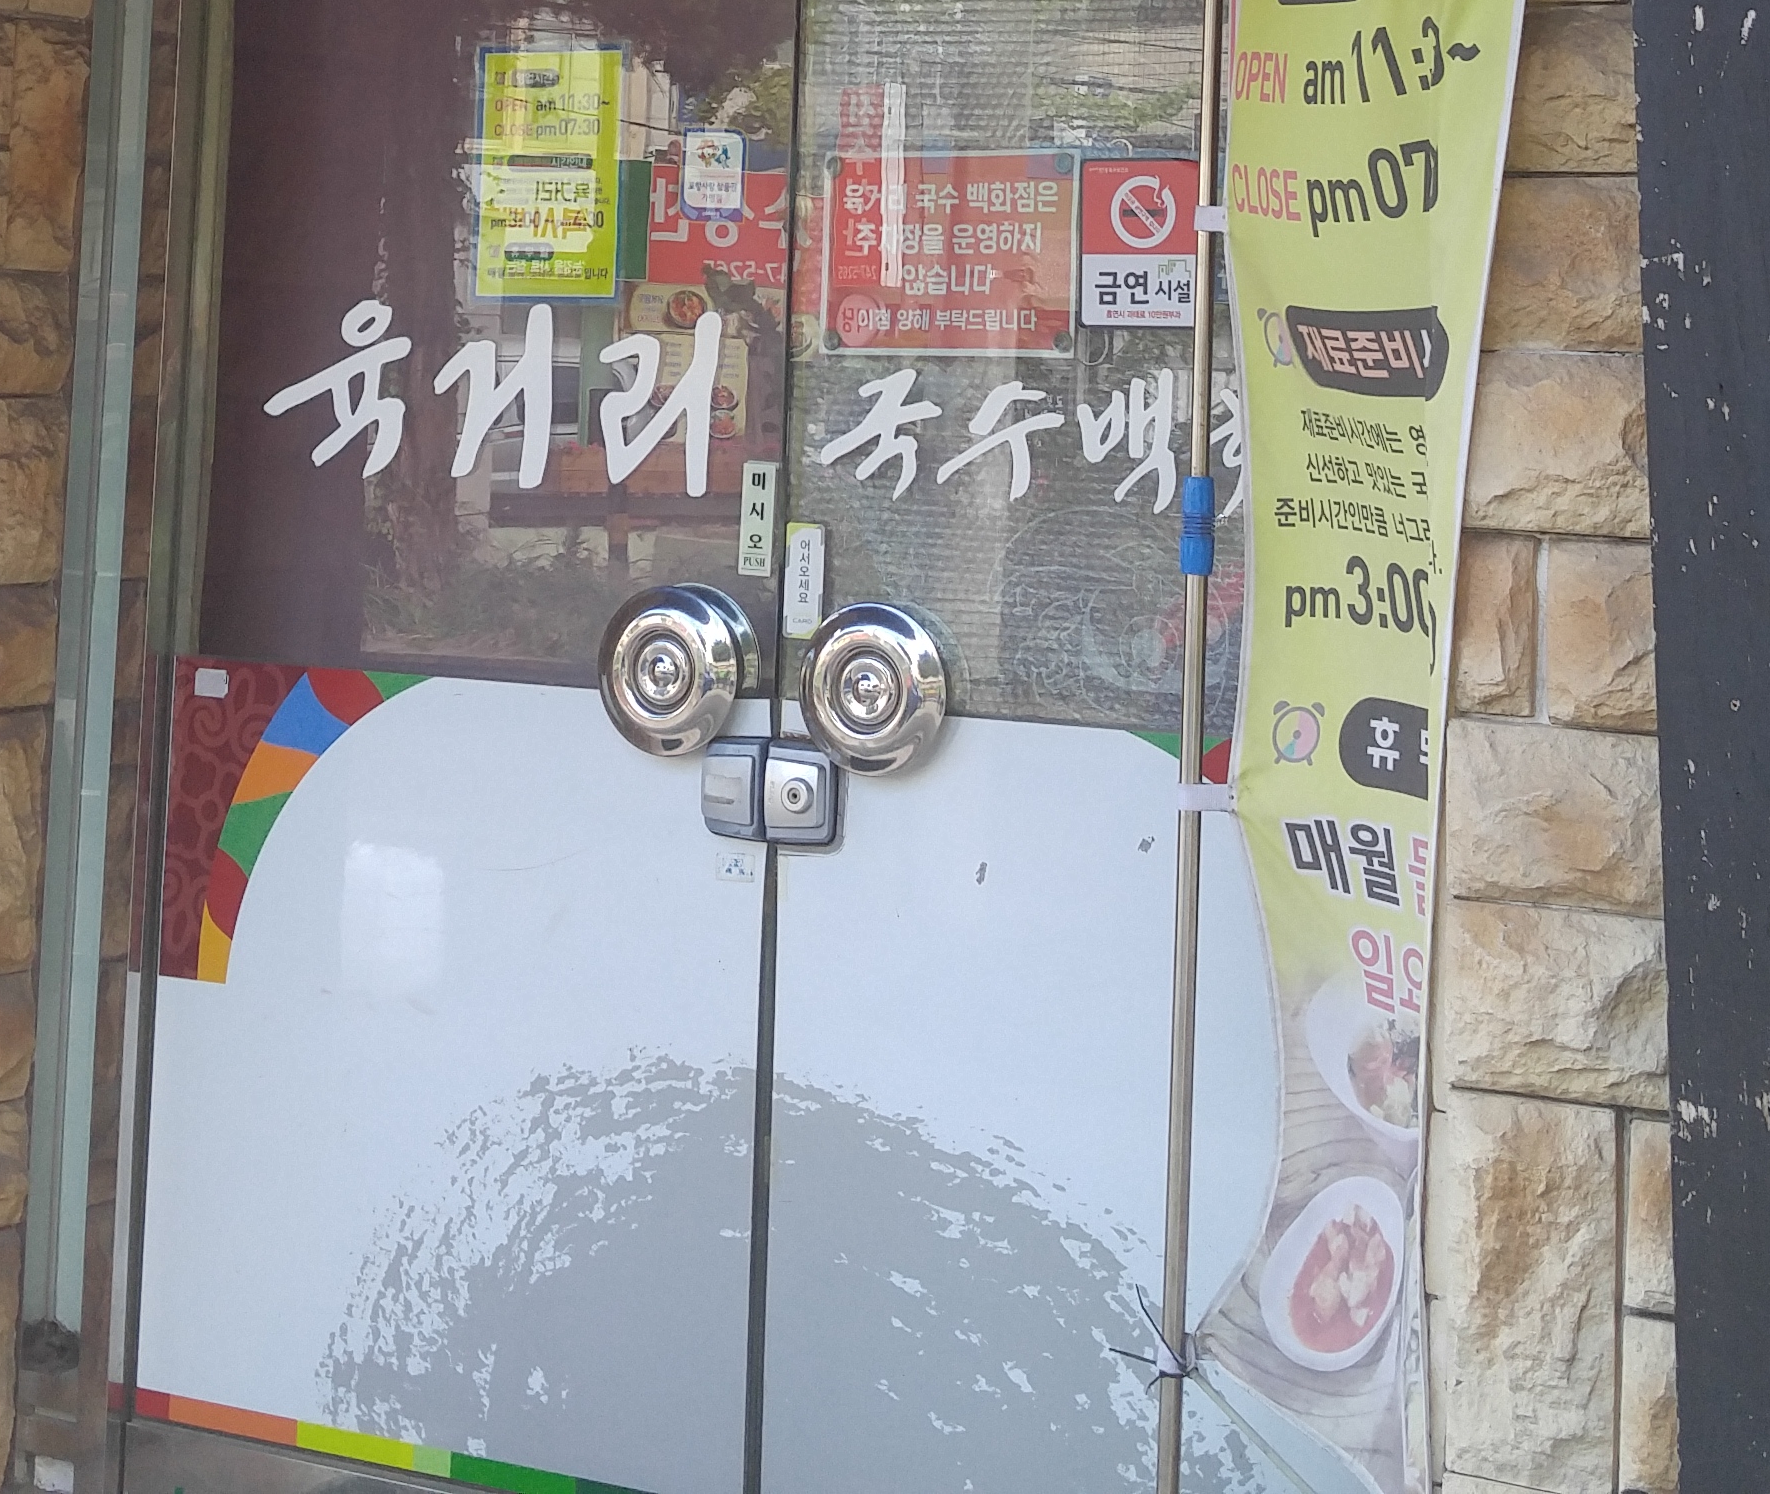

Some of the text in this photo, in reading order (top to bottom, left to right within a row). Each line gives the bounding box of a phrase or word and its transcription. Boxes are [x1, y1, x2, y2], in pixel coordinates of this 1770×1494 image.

[1235, 51, 1288, 104] OPEN
[915, 183, 960, 214] 국수
[966, 181, 1059, 214] 백화점은
[1232, 163, 1302, 222] CLOSE
[952, 221, 1042, 255] 운영하지
[902, 263, 994, 296] 않습니다
[1095, 270, 1192, 306] 금연 시설
[857, 308, 1038, 332] 이점 양해 부탁드립니다
[263, 299, 722, 497] 육거리
[1301, 409, 1404, 454] 재료준비시간에는
[1306, 453, 1364, 485] 신선하고
[1364, 462, 1406, 498] 맛있는
[748, 472, 766, 550] 미시오
[1274, 497, 1389, 537] 준비시간인만큼
[743, 556, 766, 568] PUSH
[798, 539, 811, 604] 어서오세요
[792, 617, 813, 625] CARD
[1284, 819, 1401, 906] 매월
